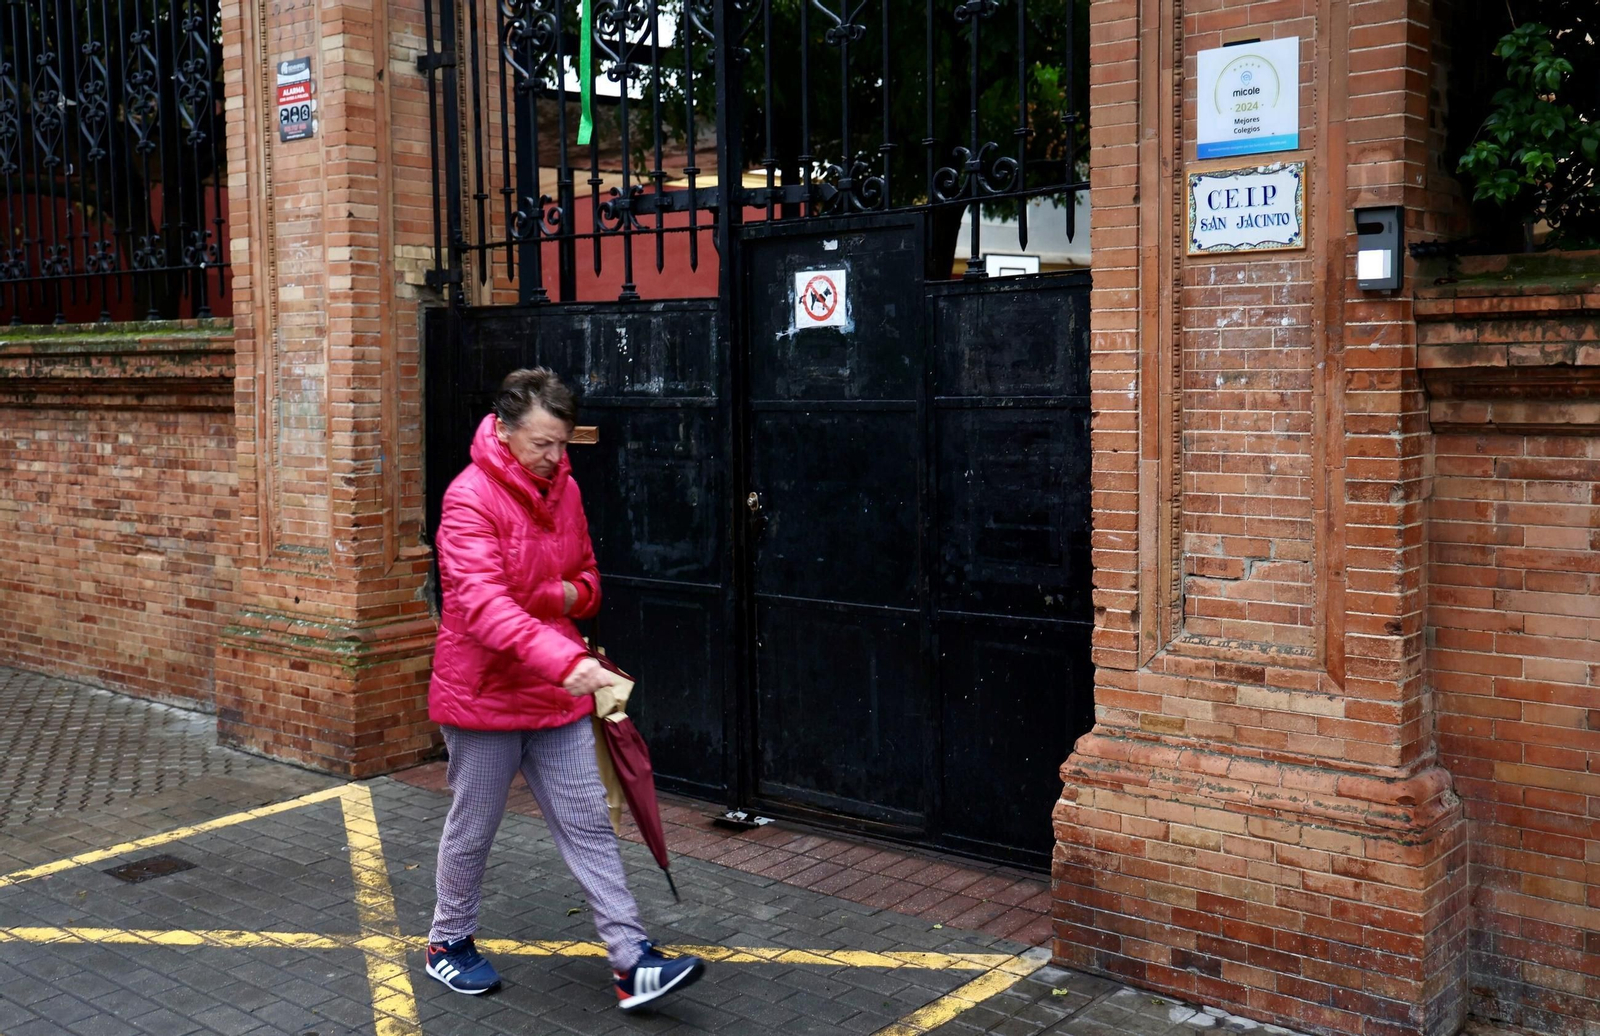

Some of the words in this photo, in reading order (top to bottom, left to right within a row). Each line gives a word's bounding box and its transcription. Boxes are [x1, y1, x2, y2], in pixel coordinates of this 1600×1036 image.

[282, 86, 305, 97] ALARMA
[1232, 86, 1260, 97] micole
[1235, 101, 1259, 112] 2024
[1233, 117, 1260, 125] Mejores
[1233, 126, 1260, 134] Colegios
[1200, 215, 1227, 231] SAN
[1236, 212, 1290, 230] JACINTO
